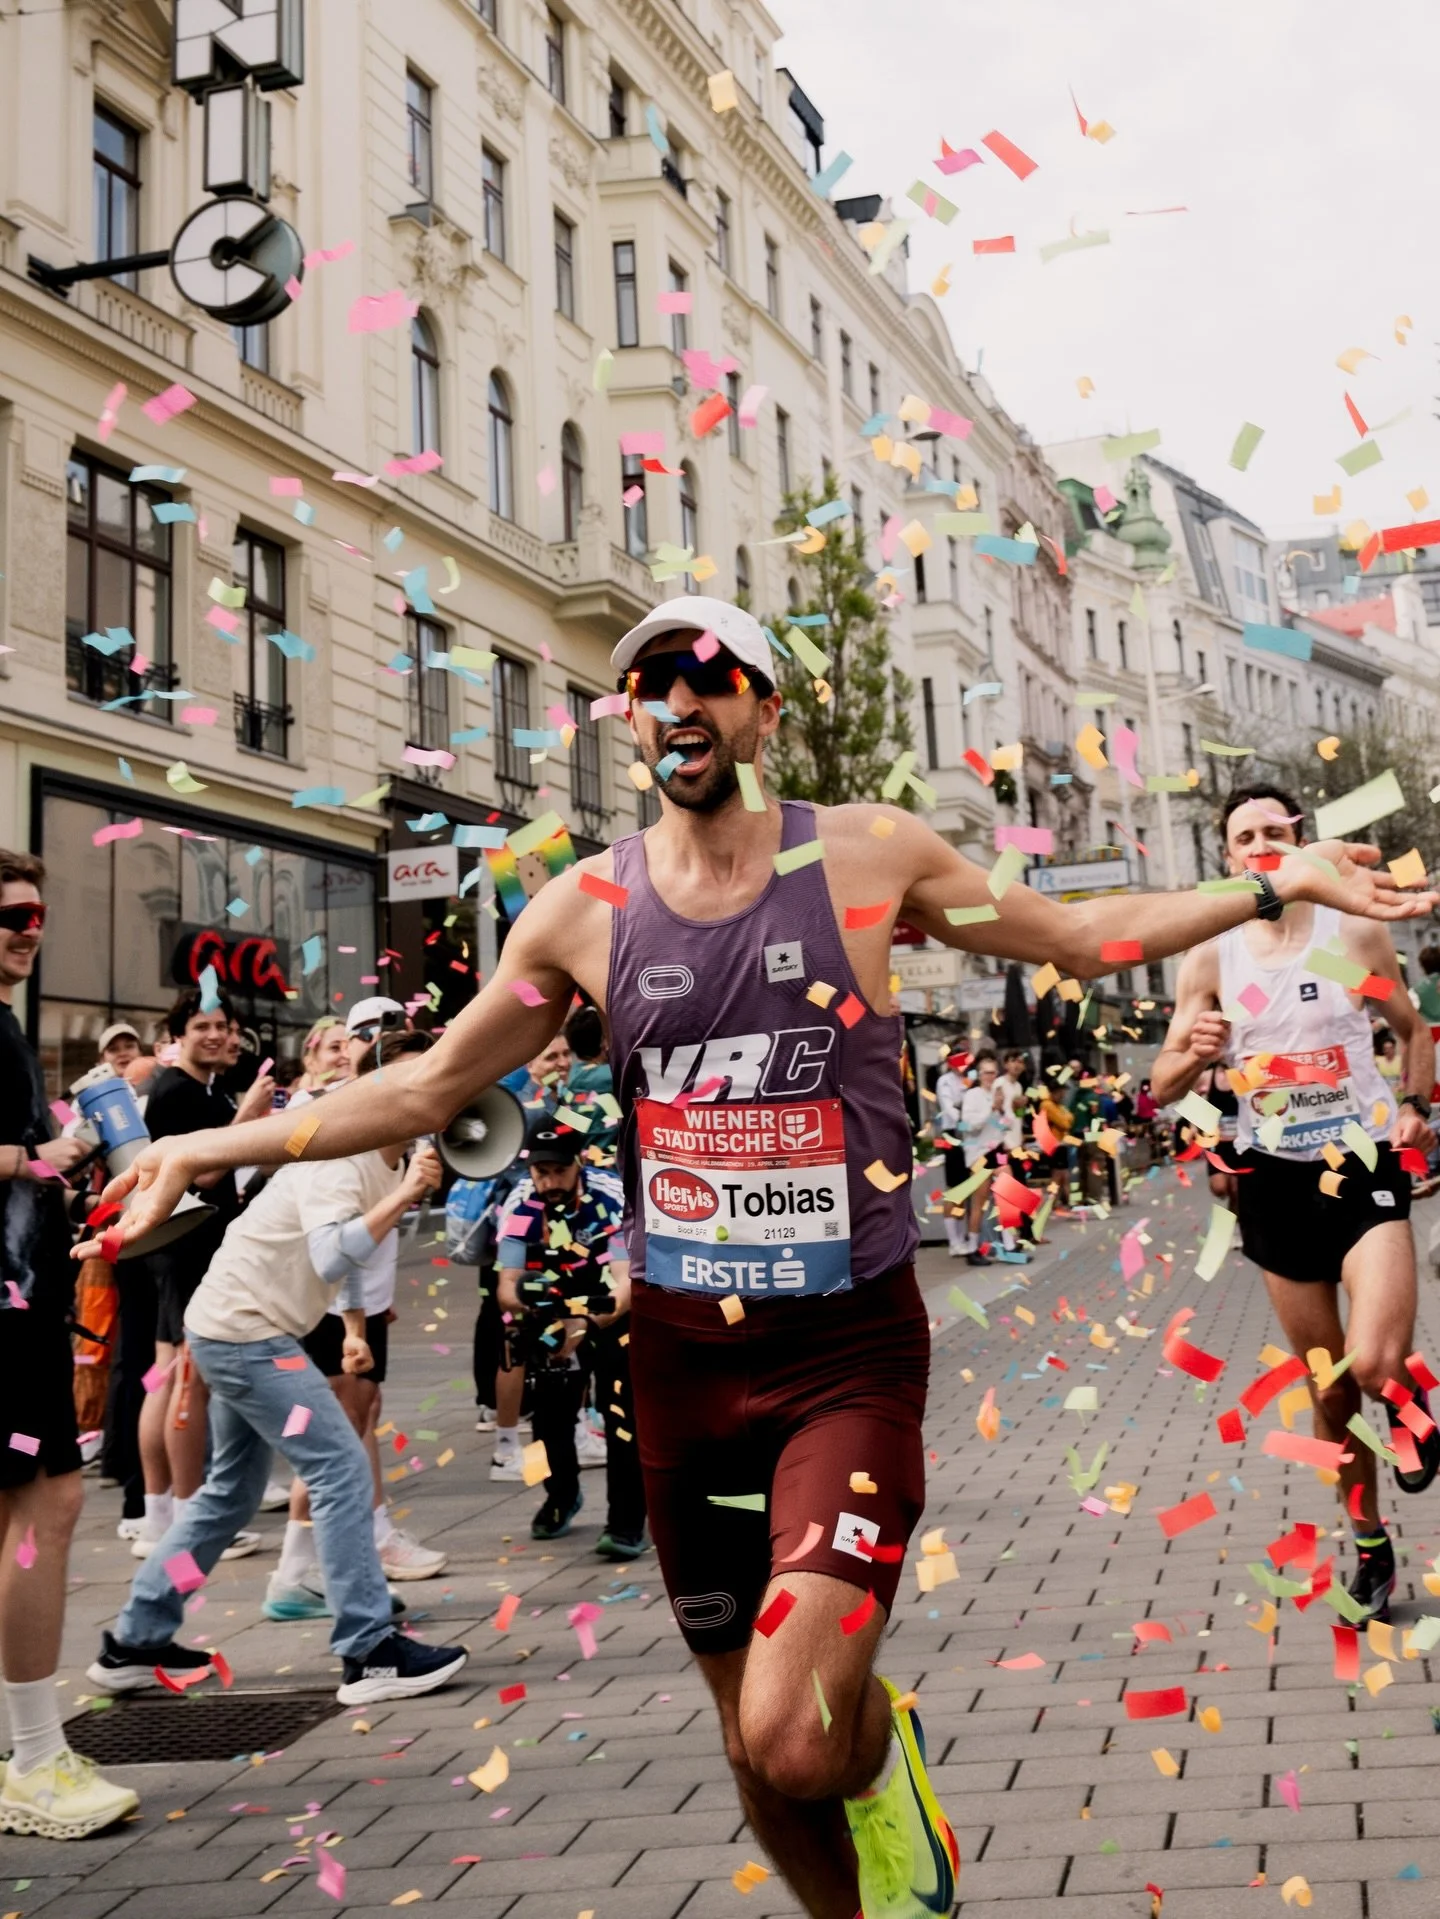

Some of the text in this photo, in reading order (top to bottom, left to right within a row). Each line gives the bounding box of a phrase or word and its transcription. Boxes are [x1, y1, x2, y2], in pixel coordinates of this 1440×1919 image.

[393, 860, 449, 881] ara
[189, 929, 299, 992] ara
[772, 964, 798, 973] SAYSKY
[636, 1026, 835, 1104] VRC
[1289, 1086, 1349, 1109] Michael
[684, 1110, 776, 1130] WIENER
[653, 1127, 776, 1153] STÄDTISCHE
[655, 1177, 714, 1211] Hervis
[721, 1181, 835, 1218] Tobias
[663, 1202, 688, 1213] SPORTS
[764, 1227, 796, 1239] 21129
[681, 1254, 768, 1290] ERSTE
